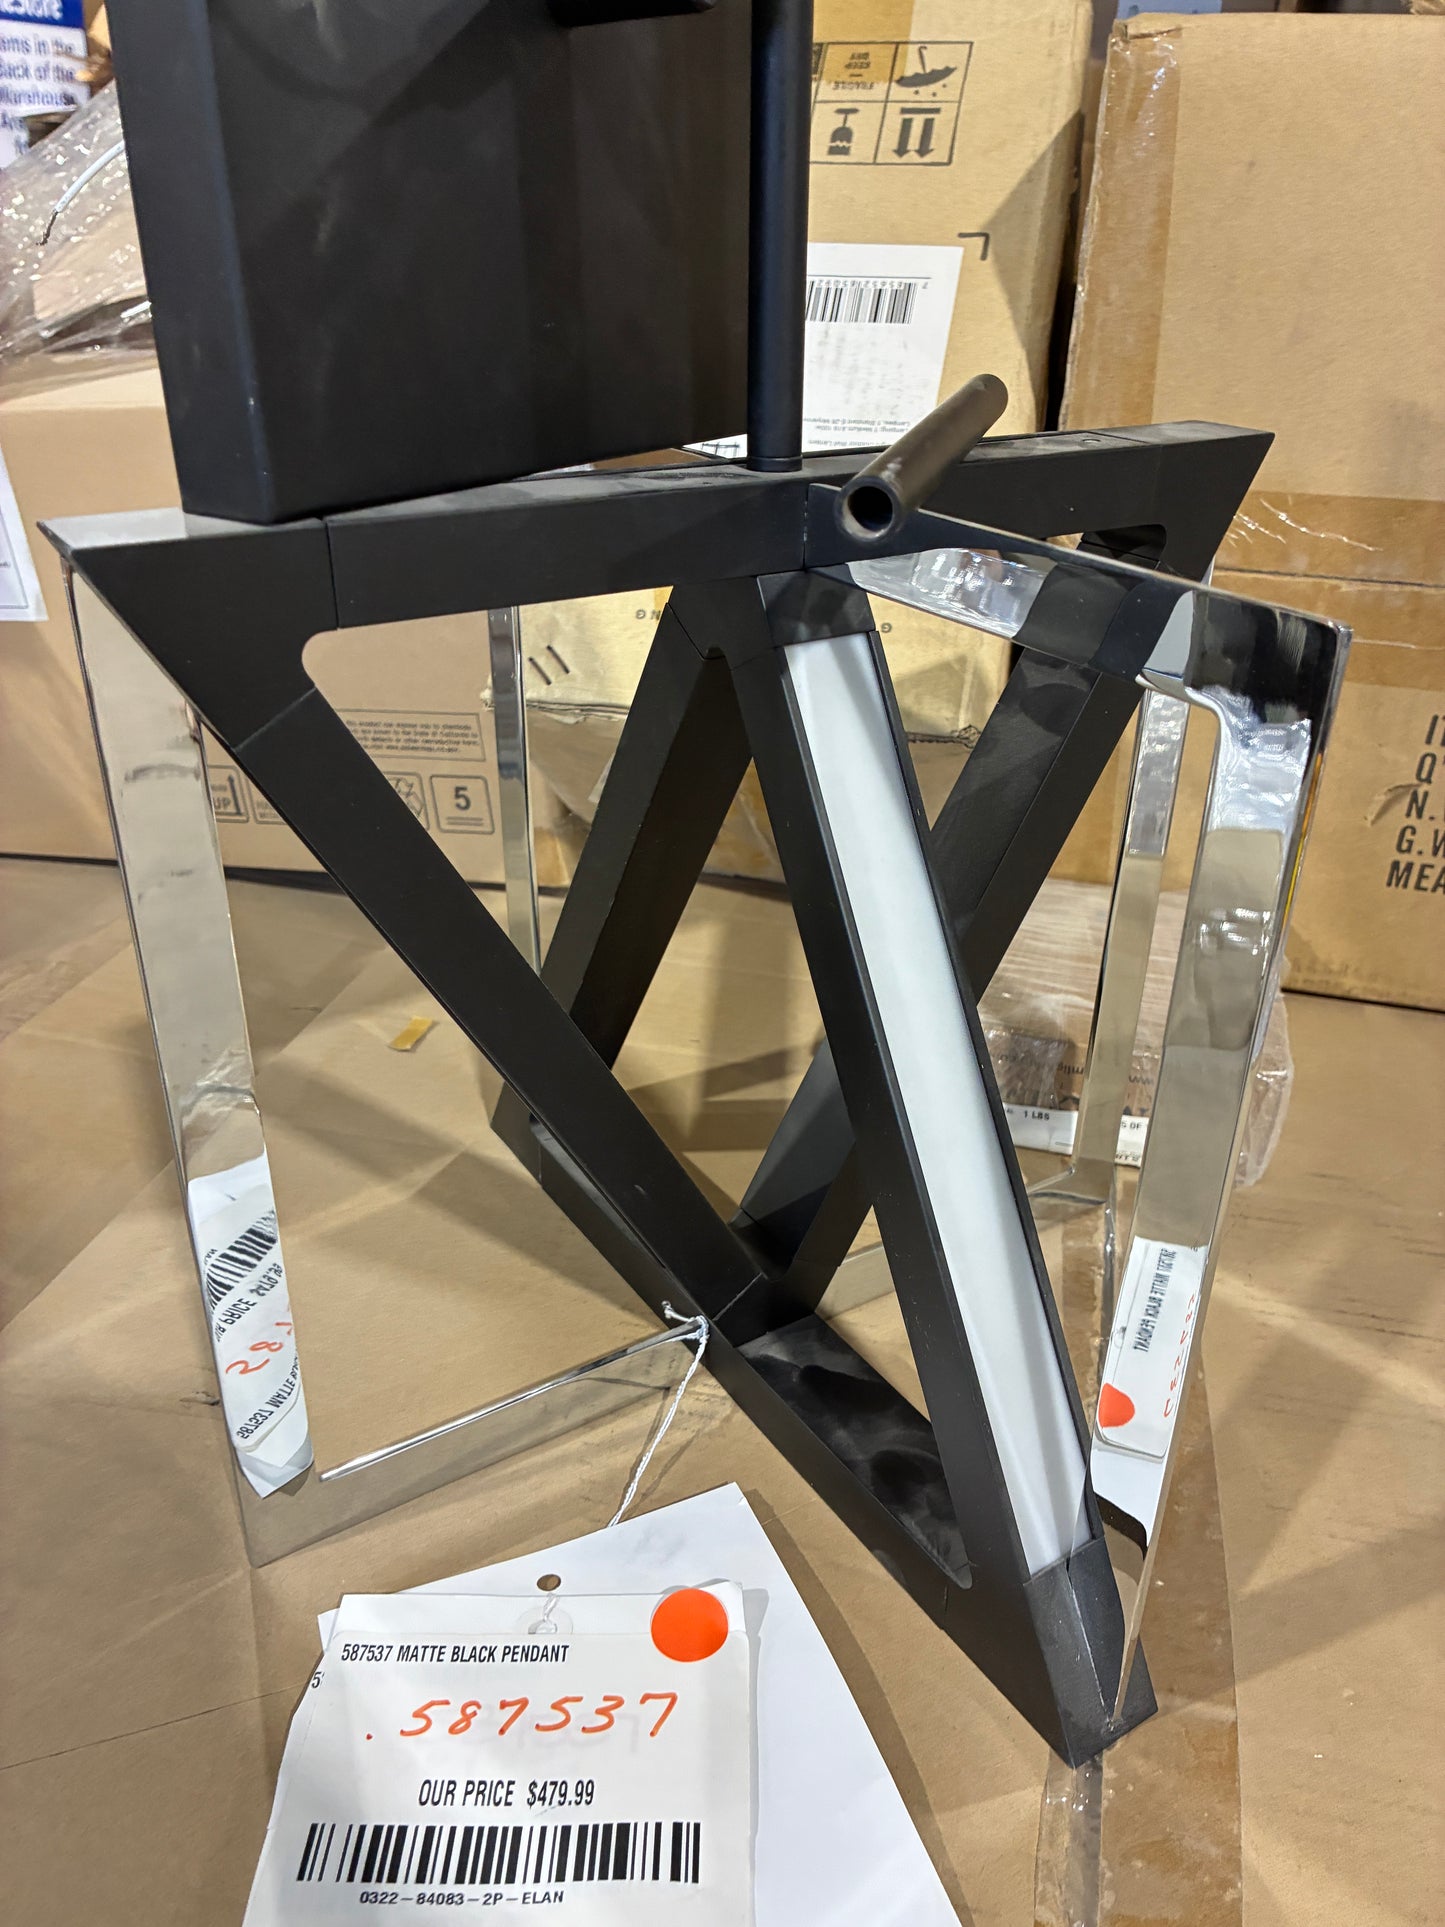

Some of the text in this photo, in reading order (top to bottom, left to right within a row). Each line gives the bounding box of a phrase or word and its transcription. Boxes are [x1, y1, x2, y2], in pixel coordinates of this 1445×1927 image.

[454, 786, 472, 811] 5
[341, 1643, 570, 1664] 587537 MATTE BLACK PENDANT
[399, 1691, 679, 1738] 587537
[418, 1779, 596, 1808] OUR PRICE $479.99
